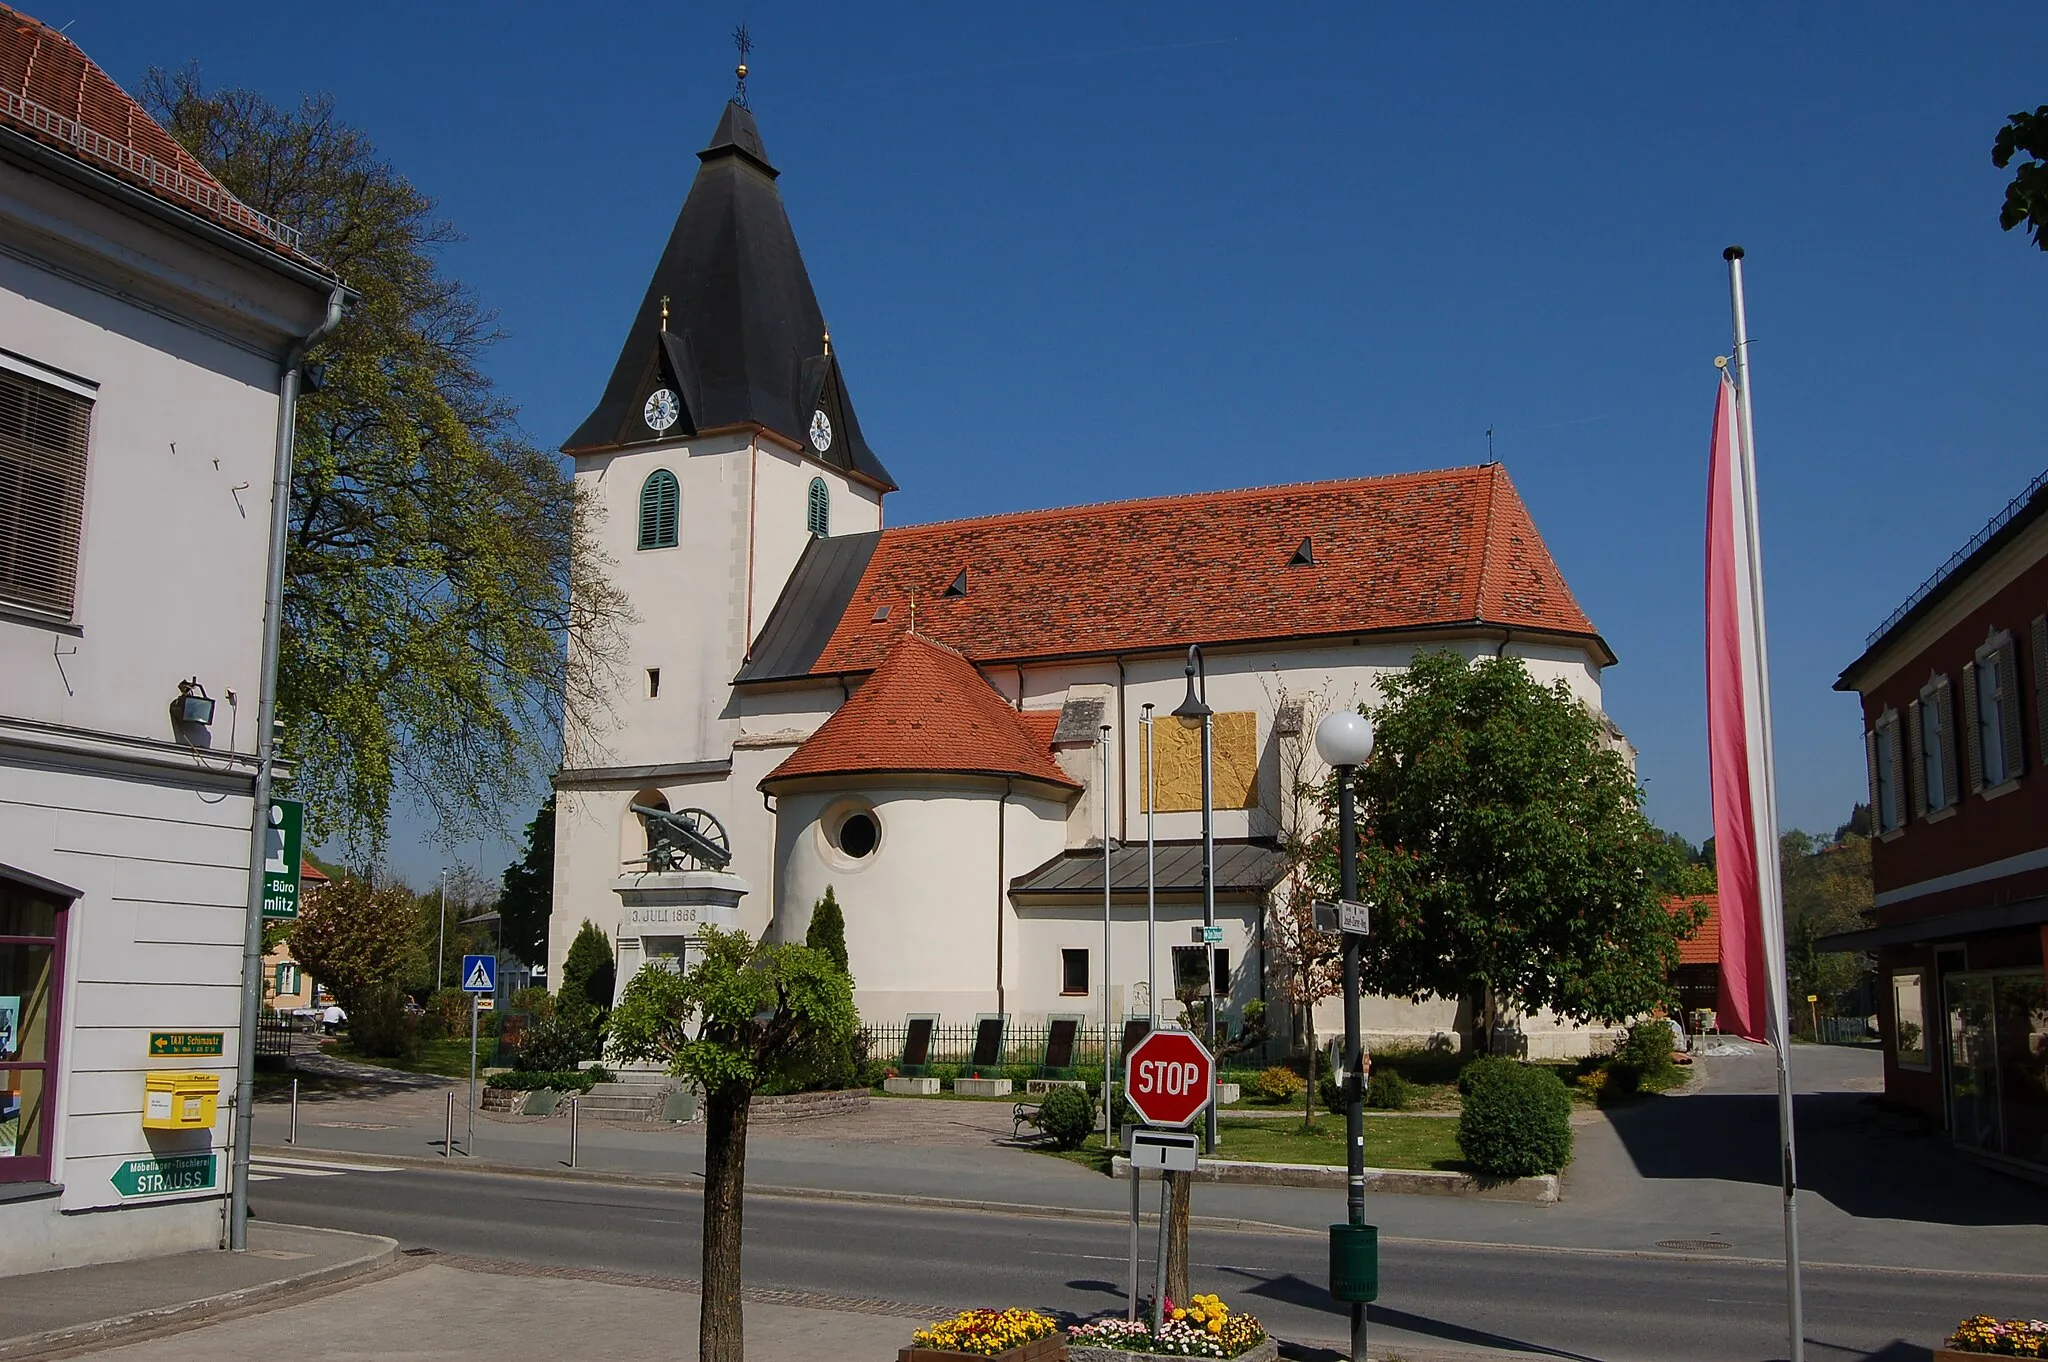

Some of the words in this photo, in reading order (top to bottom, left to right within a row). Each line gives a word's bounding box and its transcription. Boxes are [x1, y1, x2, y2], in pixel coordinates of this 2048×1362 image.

[263, 880, 295, 893] -Büro
[264, 896, 293, 912] mlitz
[632, 910, 641, 922] 3.
[643, 909, 669, 922] JULI
[672, 909, 697, 922] 1866
[170, 1035, 185, 1045] TAXI
[1138, 1060, 1199, 1096] STOP
[130, 1158, 210, 1173] Möbellager-Tischlerei
[137, 1171, 202, 1192] STRAUSS
